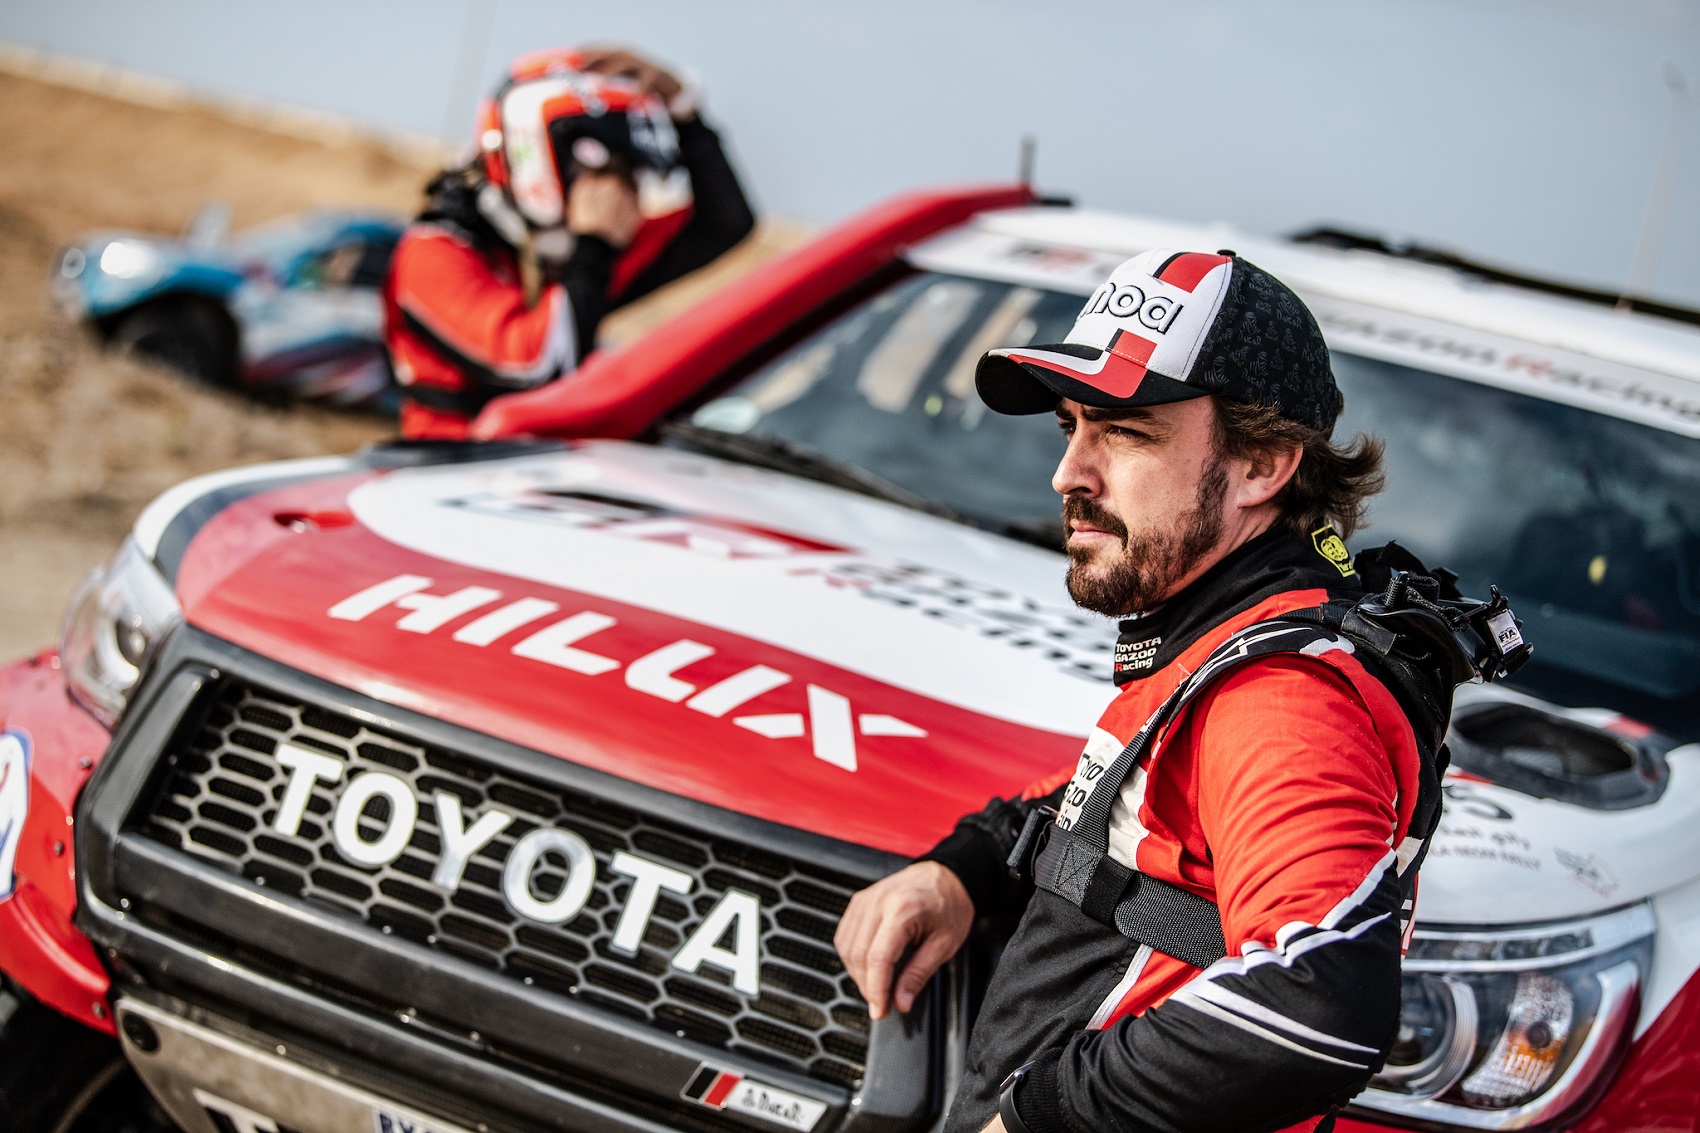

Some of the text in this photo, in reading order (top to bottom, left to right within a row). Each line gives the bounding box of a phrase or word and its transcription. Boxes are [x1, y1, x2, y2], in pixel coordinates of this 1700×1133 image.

[1499, 629, 1516, 642] FIA
[1116, 636, 1162, 653] TOYOTA
[1115, 657, 1154, 672] Racing
[327, 574, 928, 773] HILUX
[272, 741, 761, 998] TOYOTA
